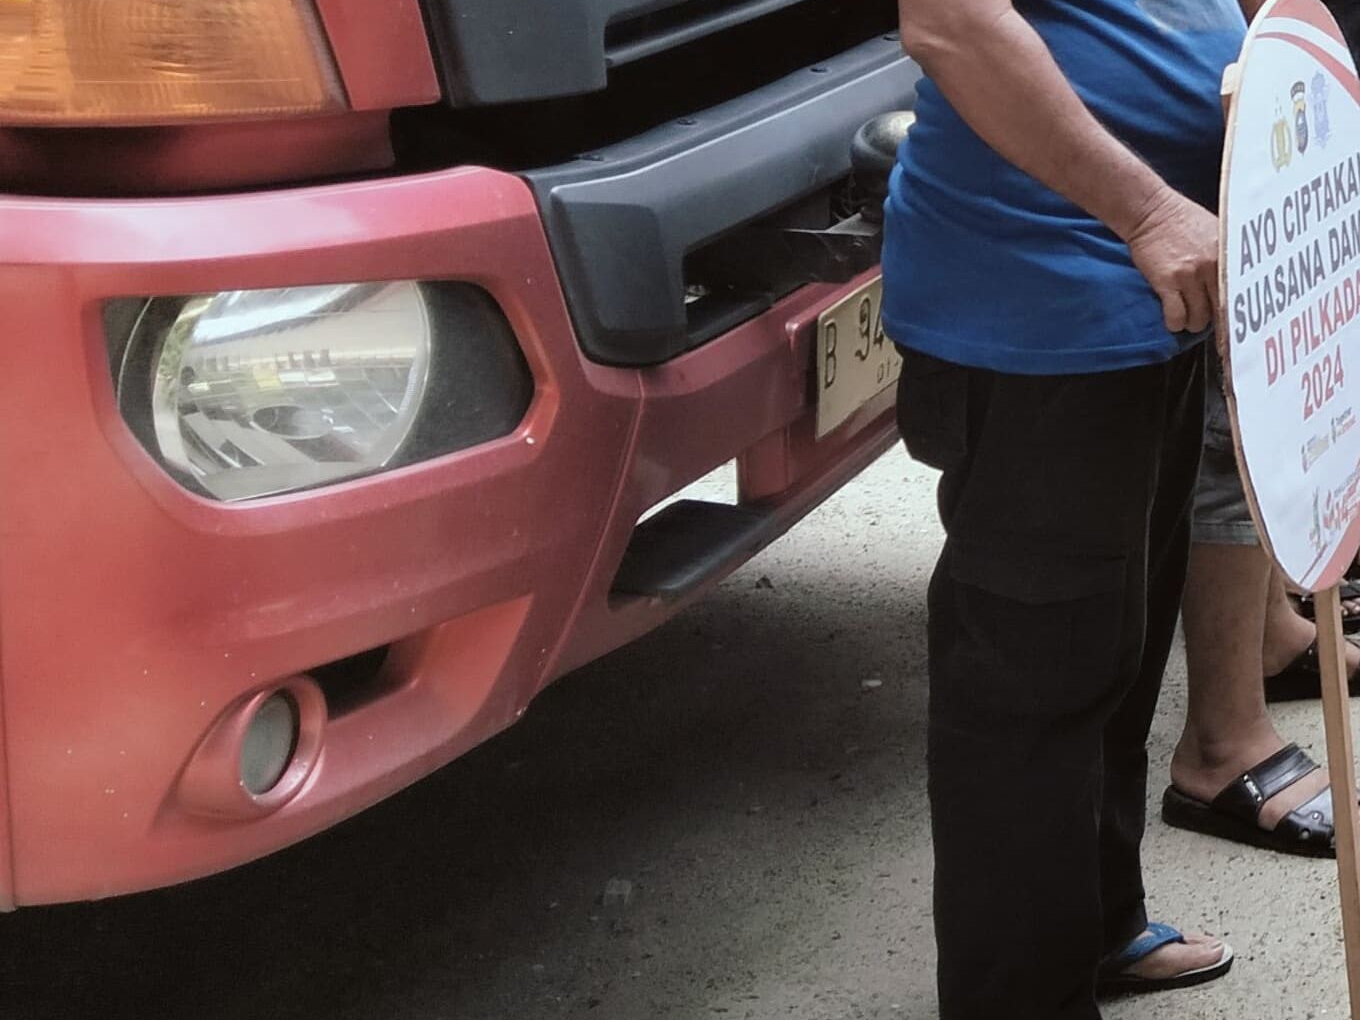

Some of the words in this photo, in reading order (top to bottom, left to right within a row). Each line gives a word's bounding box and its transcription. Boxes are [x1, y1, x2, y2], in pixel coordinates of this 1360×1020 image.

[1240, 208, 1276, 276] AYO
[1234, 238, 1325, 344] SUASANA
[823, 319, 837, 390] B
[1265, 328, 1285, 386] DI
[1302, 344, 1344, 421] 2024
